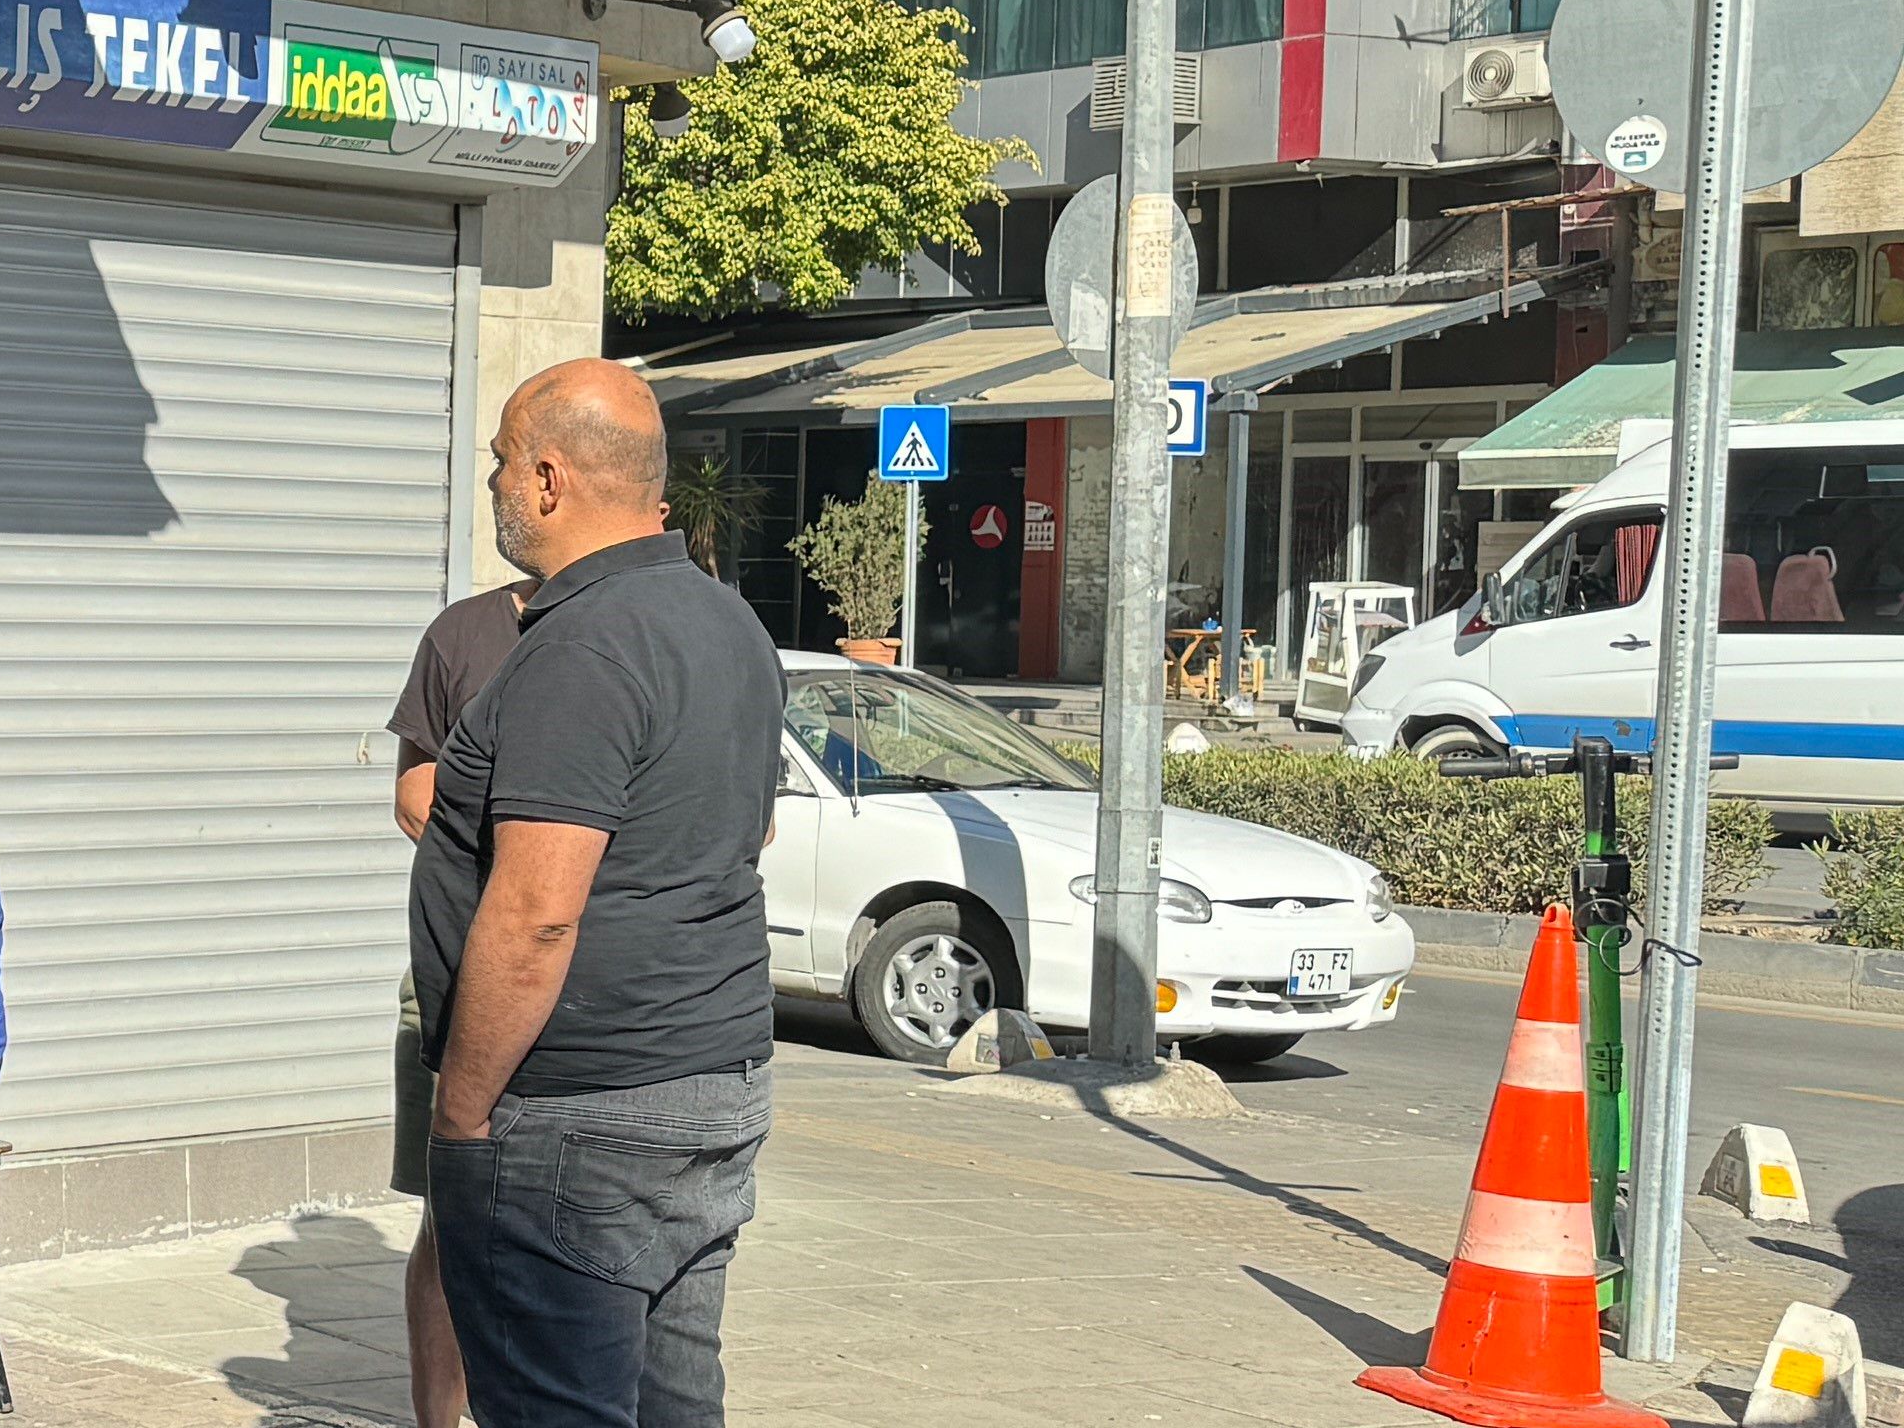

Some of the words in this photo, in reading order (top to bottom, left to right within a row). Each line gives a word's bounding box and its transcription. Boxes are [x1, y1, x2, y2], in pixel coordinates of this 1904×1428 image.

[85, 13, 251, 113] TEKEL
[497, 58, 566, 84] SAYISAL
[285, 55, 388, 122] iddaa
[1297, 953, 1314, 971] 33
[1332, 953, 1348, 970] FZ
[1309, 974, 1332, 990] 471
